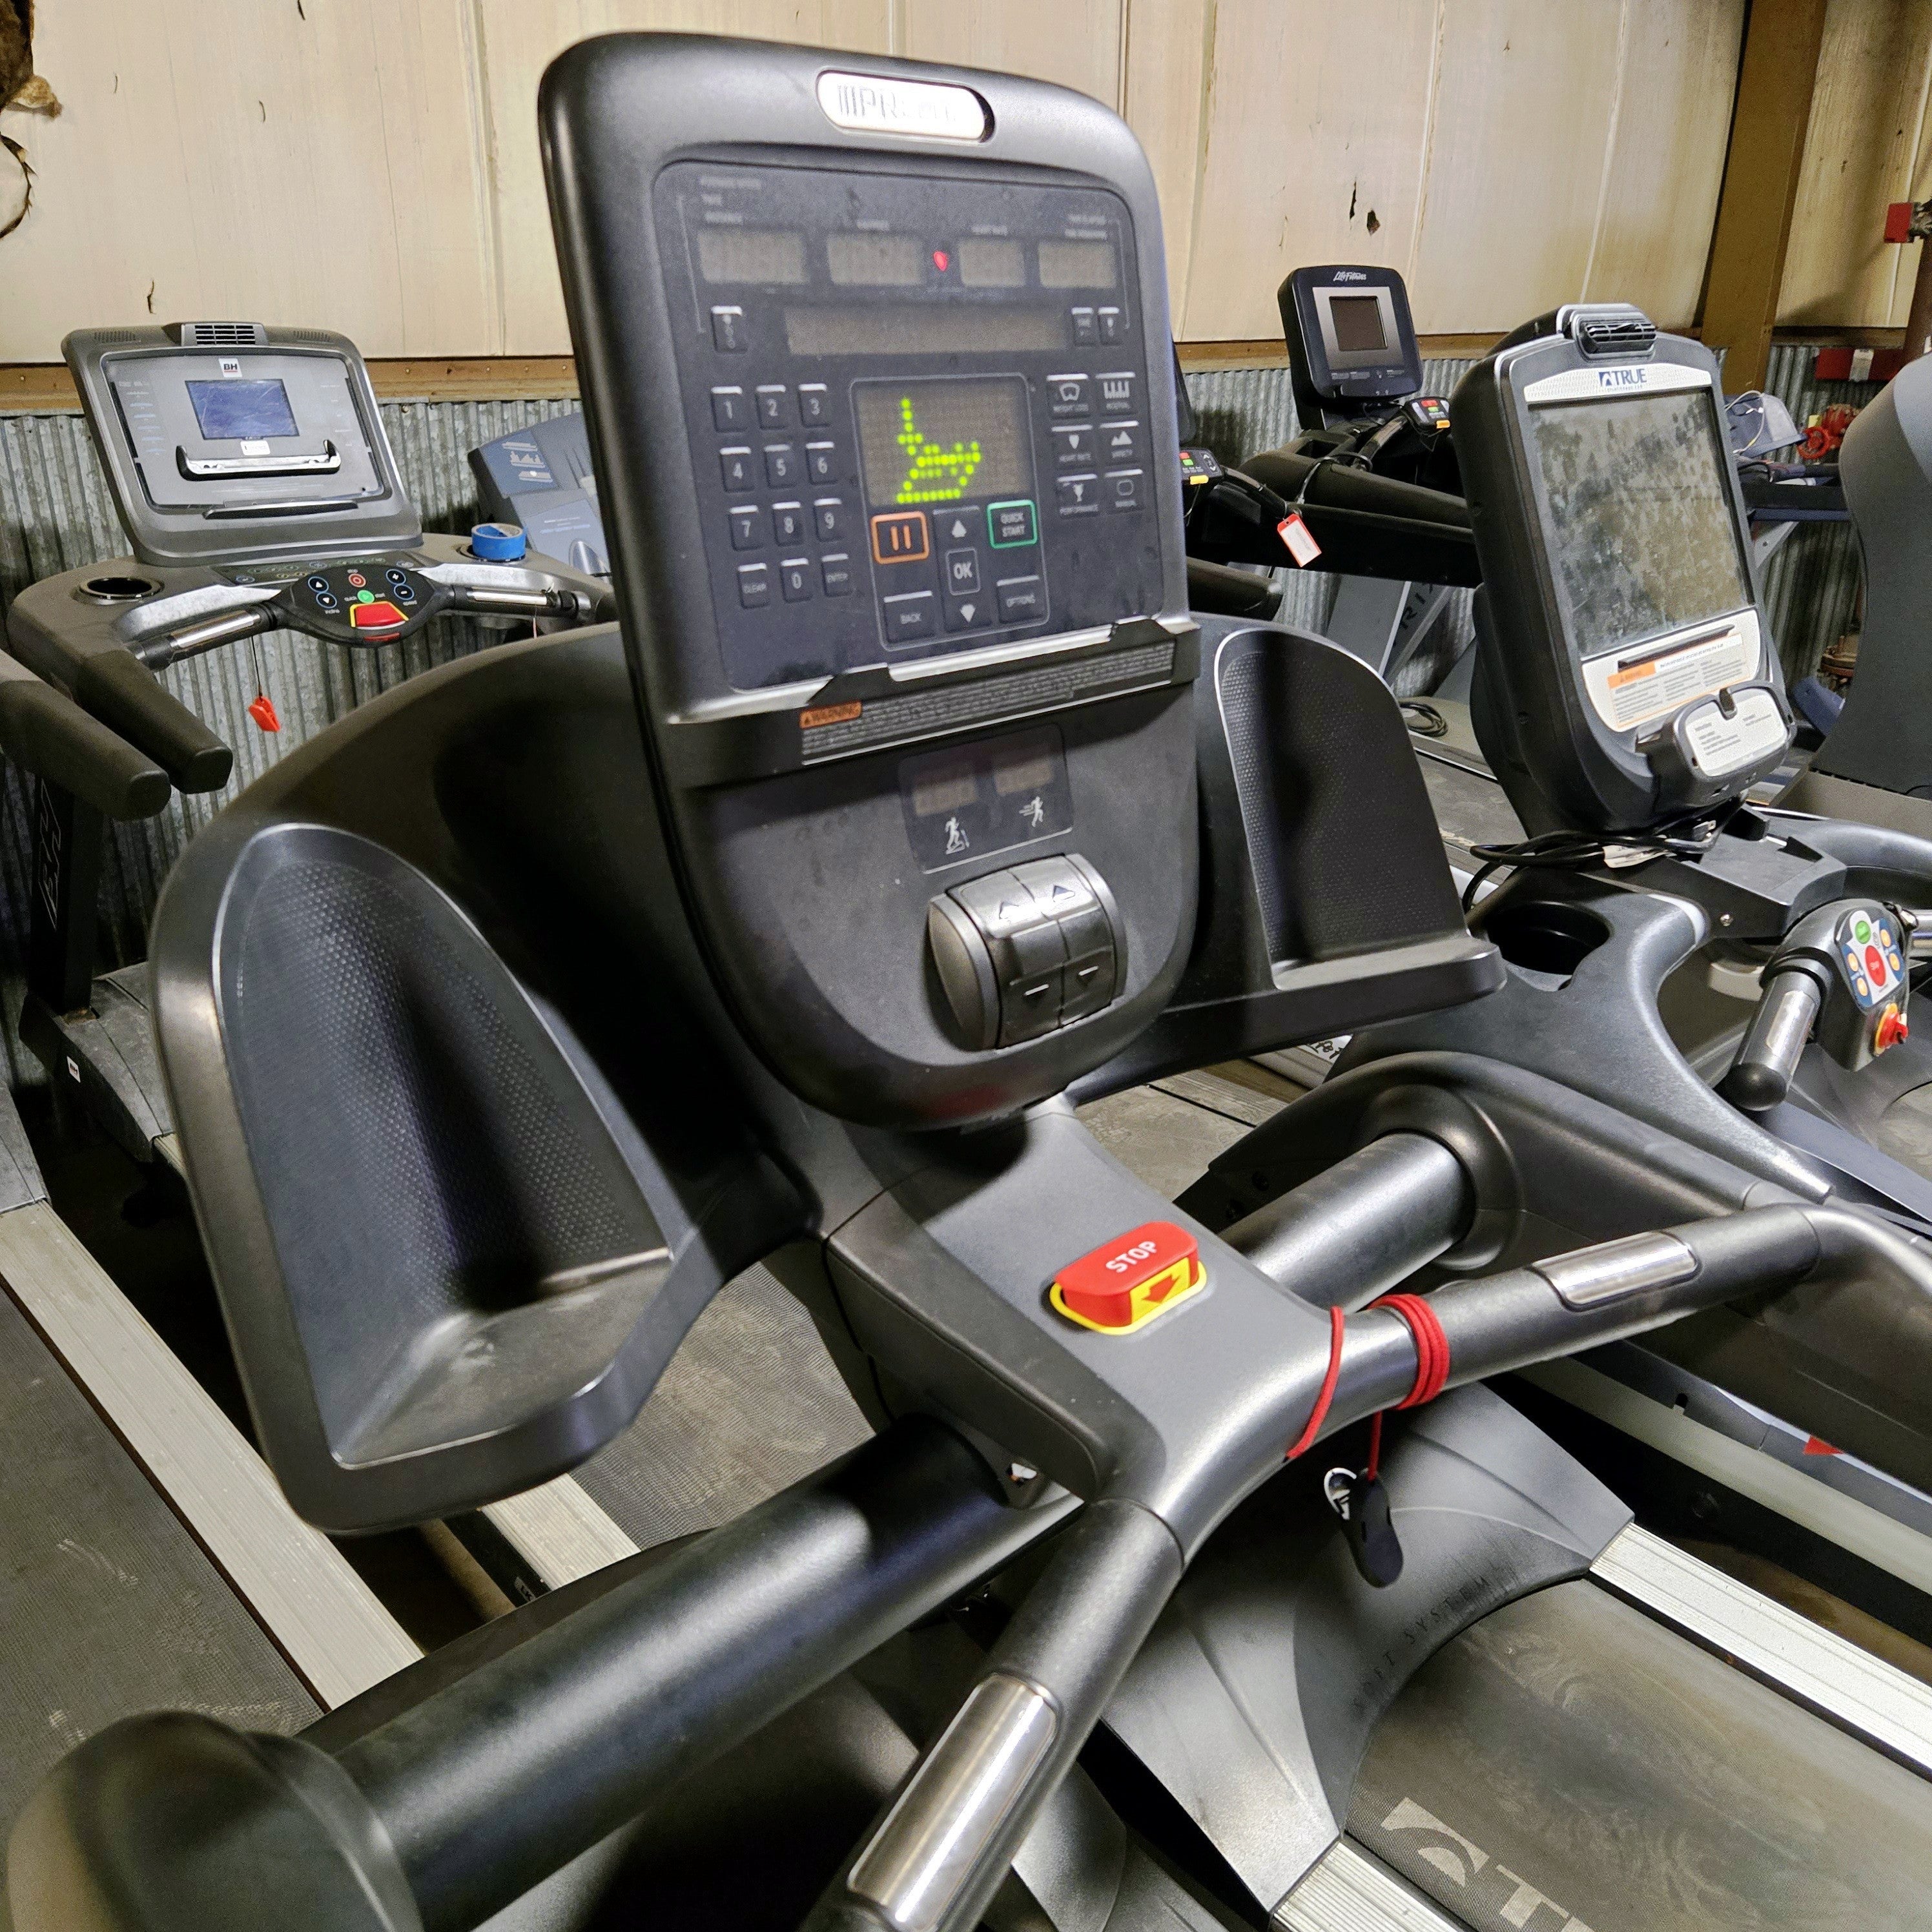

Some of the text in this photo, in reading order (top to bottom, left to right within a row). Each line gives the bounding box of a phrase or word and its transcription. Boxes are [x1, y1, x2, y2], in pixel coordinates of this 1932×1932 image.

[1612, 368, 1647, 386] TRUE
[723, 397, 821, 419] 1 2 3
[732, 457, 828, 479] 4 5 6
[741, 511, 835, 538] 7 8 9
[790, 571, 802, 589] 0
[953, 562, 973, 579] OK
[899, 612, 922, 624] BACK
[1105, 1240, 1157, 1273] STOP
